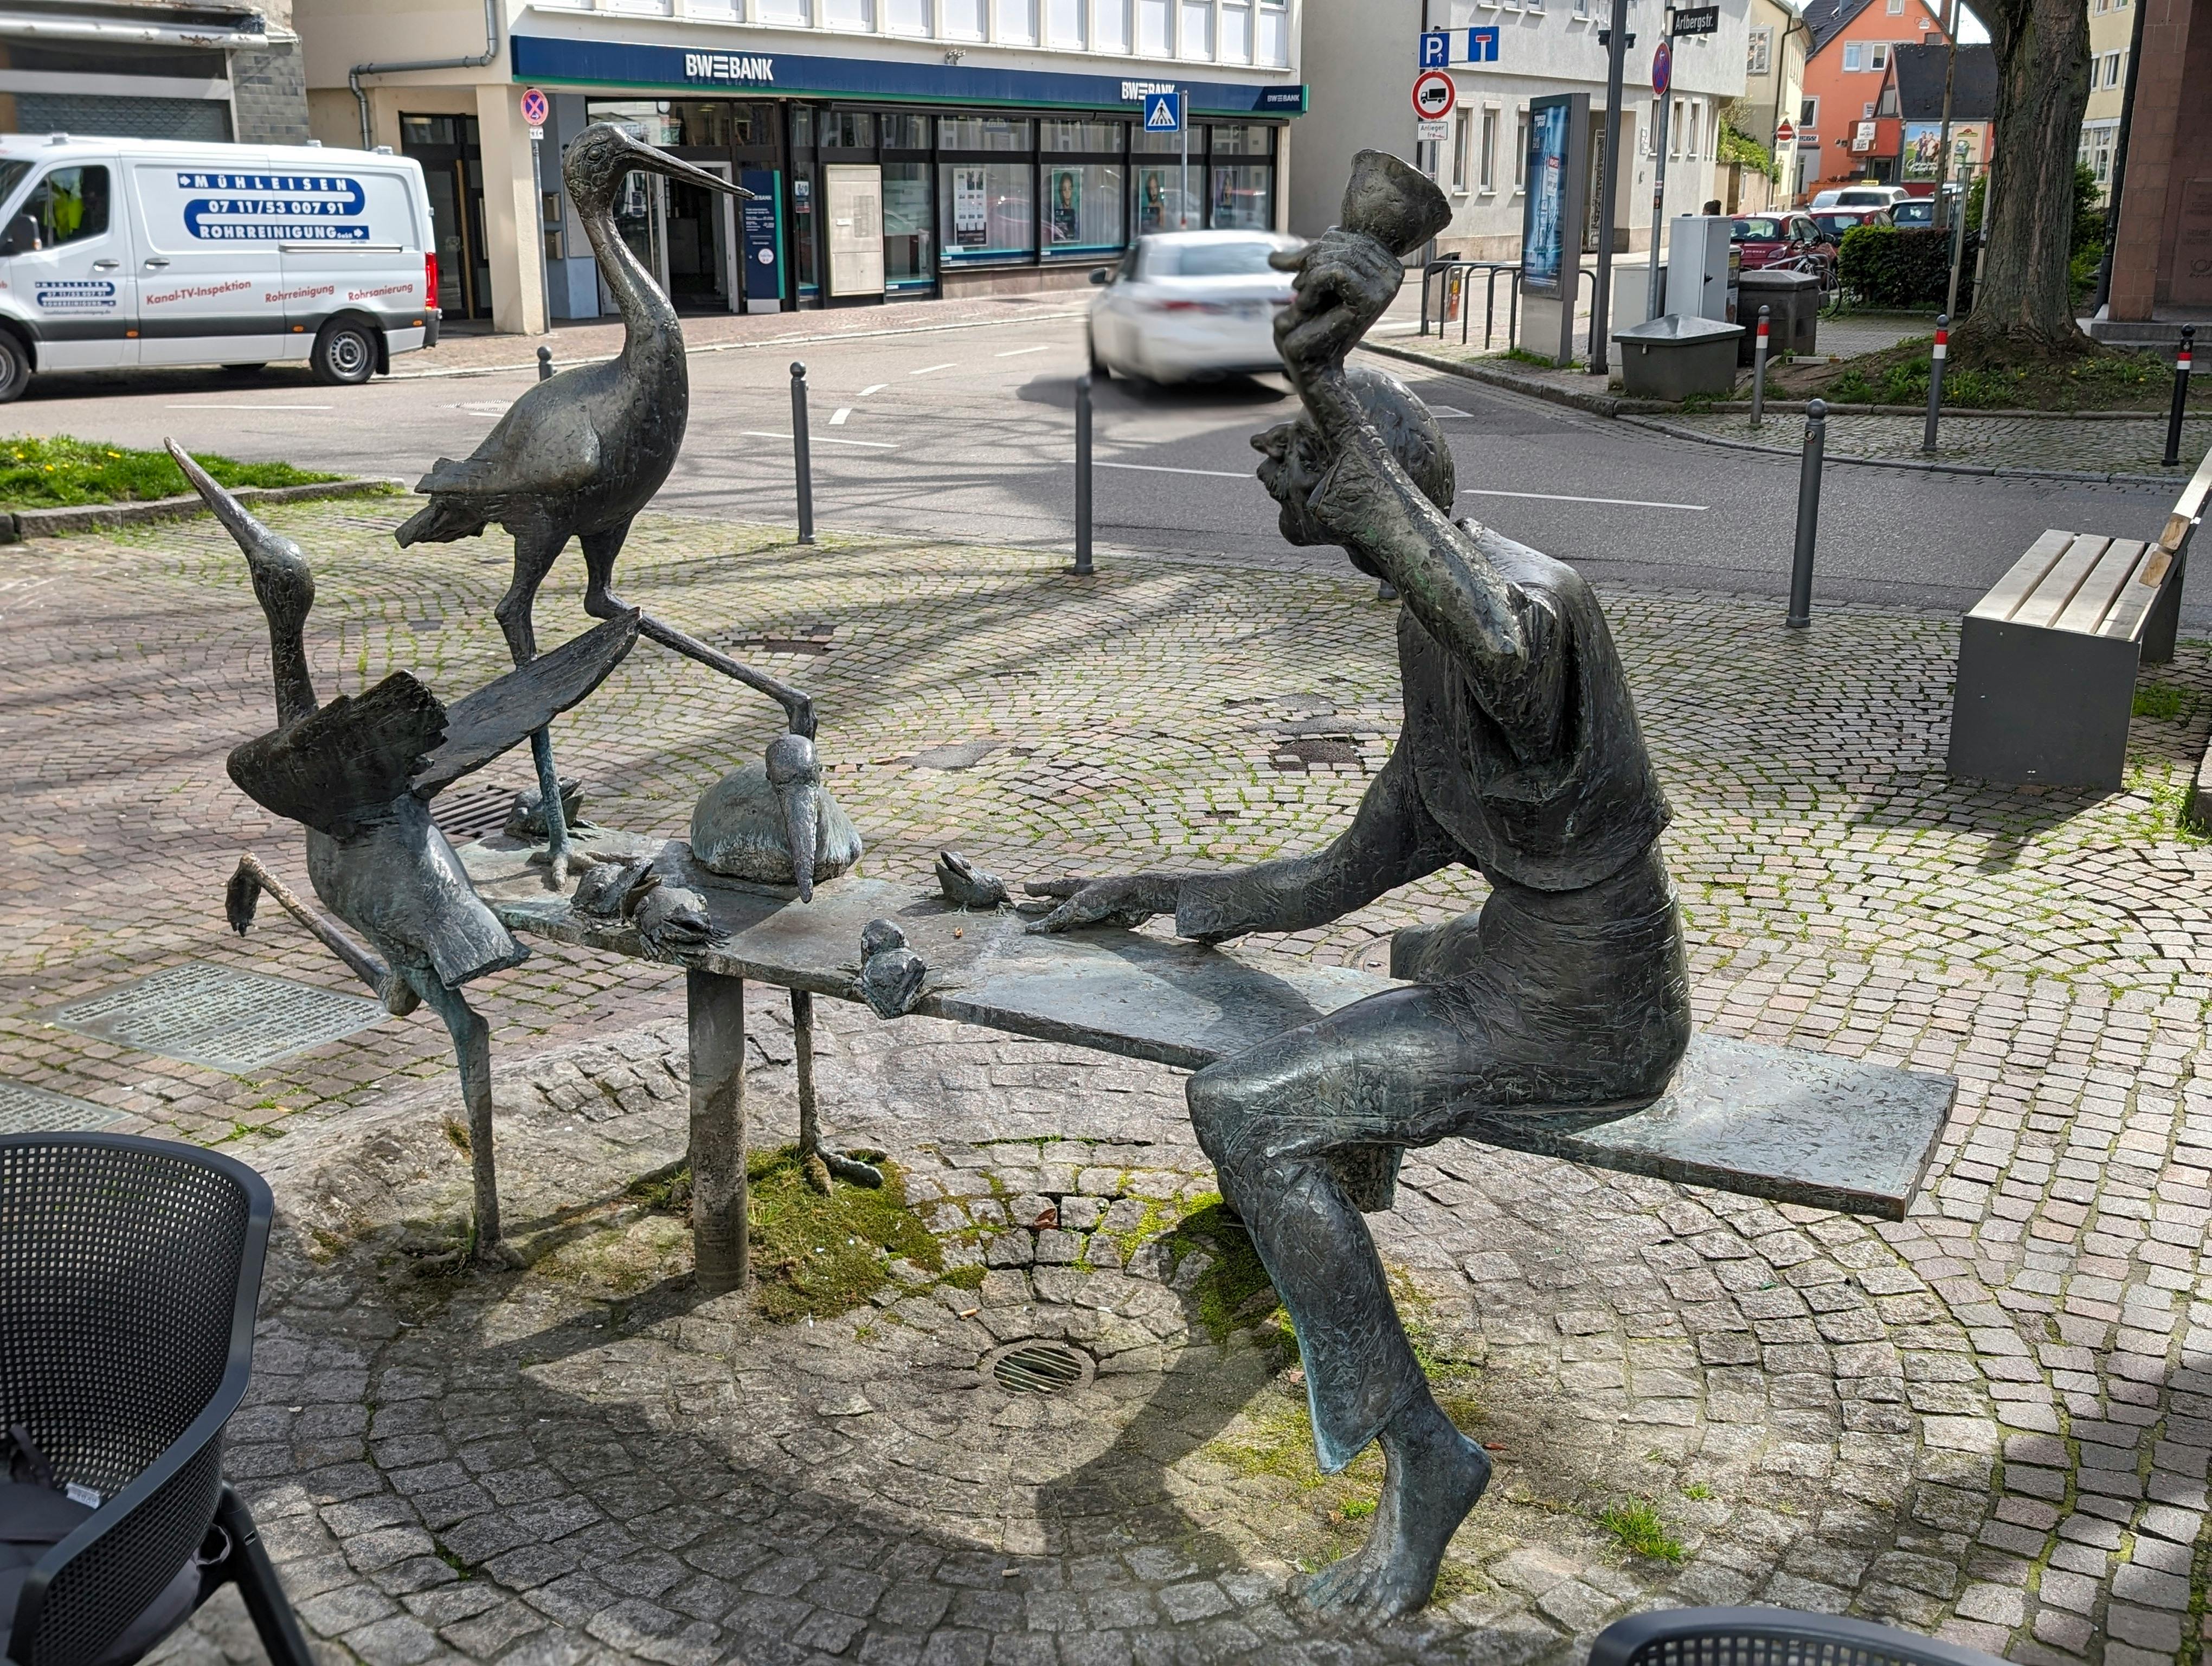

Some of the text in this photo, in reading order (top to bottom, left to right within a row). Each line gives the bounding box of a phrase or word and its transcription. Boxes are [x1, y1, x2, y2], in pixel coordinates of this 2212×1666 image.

[1675, 13, 1713, 32] Arlbergstr.
[1425, 37, 1443, 64] P
[208, 201, 229, 213] 07
[291, 203, 321, 214] 007
[326, 203, 344, 214] 91
[199, 226, 337, 239] ROHRREINIGUNG
[146, 280, 252, 305] Kanal-TV-Inspektion
[265, 284, 335, 303] Rohrreinigung
[348, 283, 414, 302] Rohrsanierung
